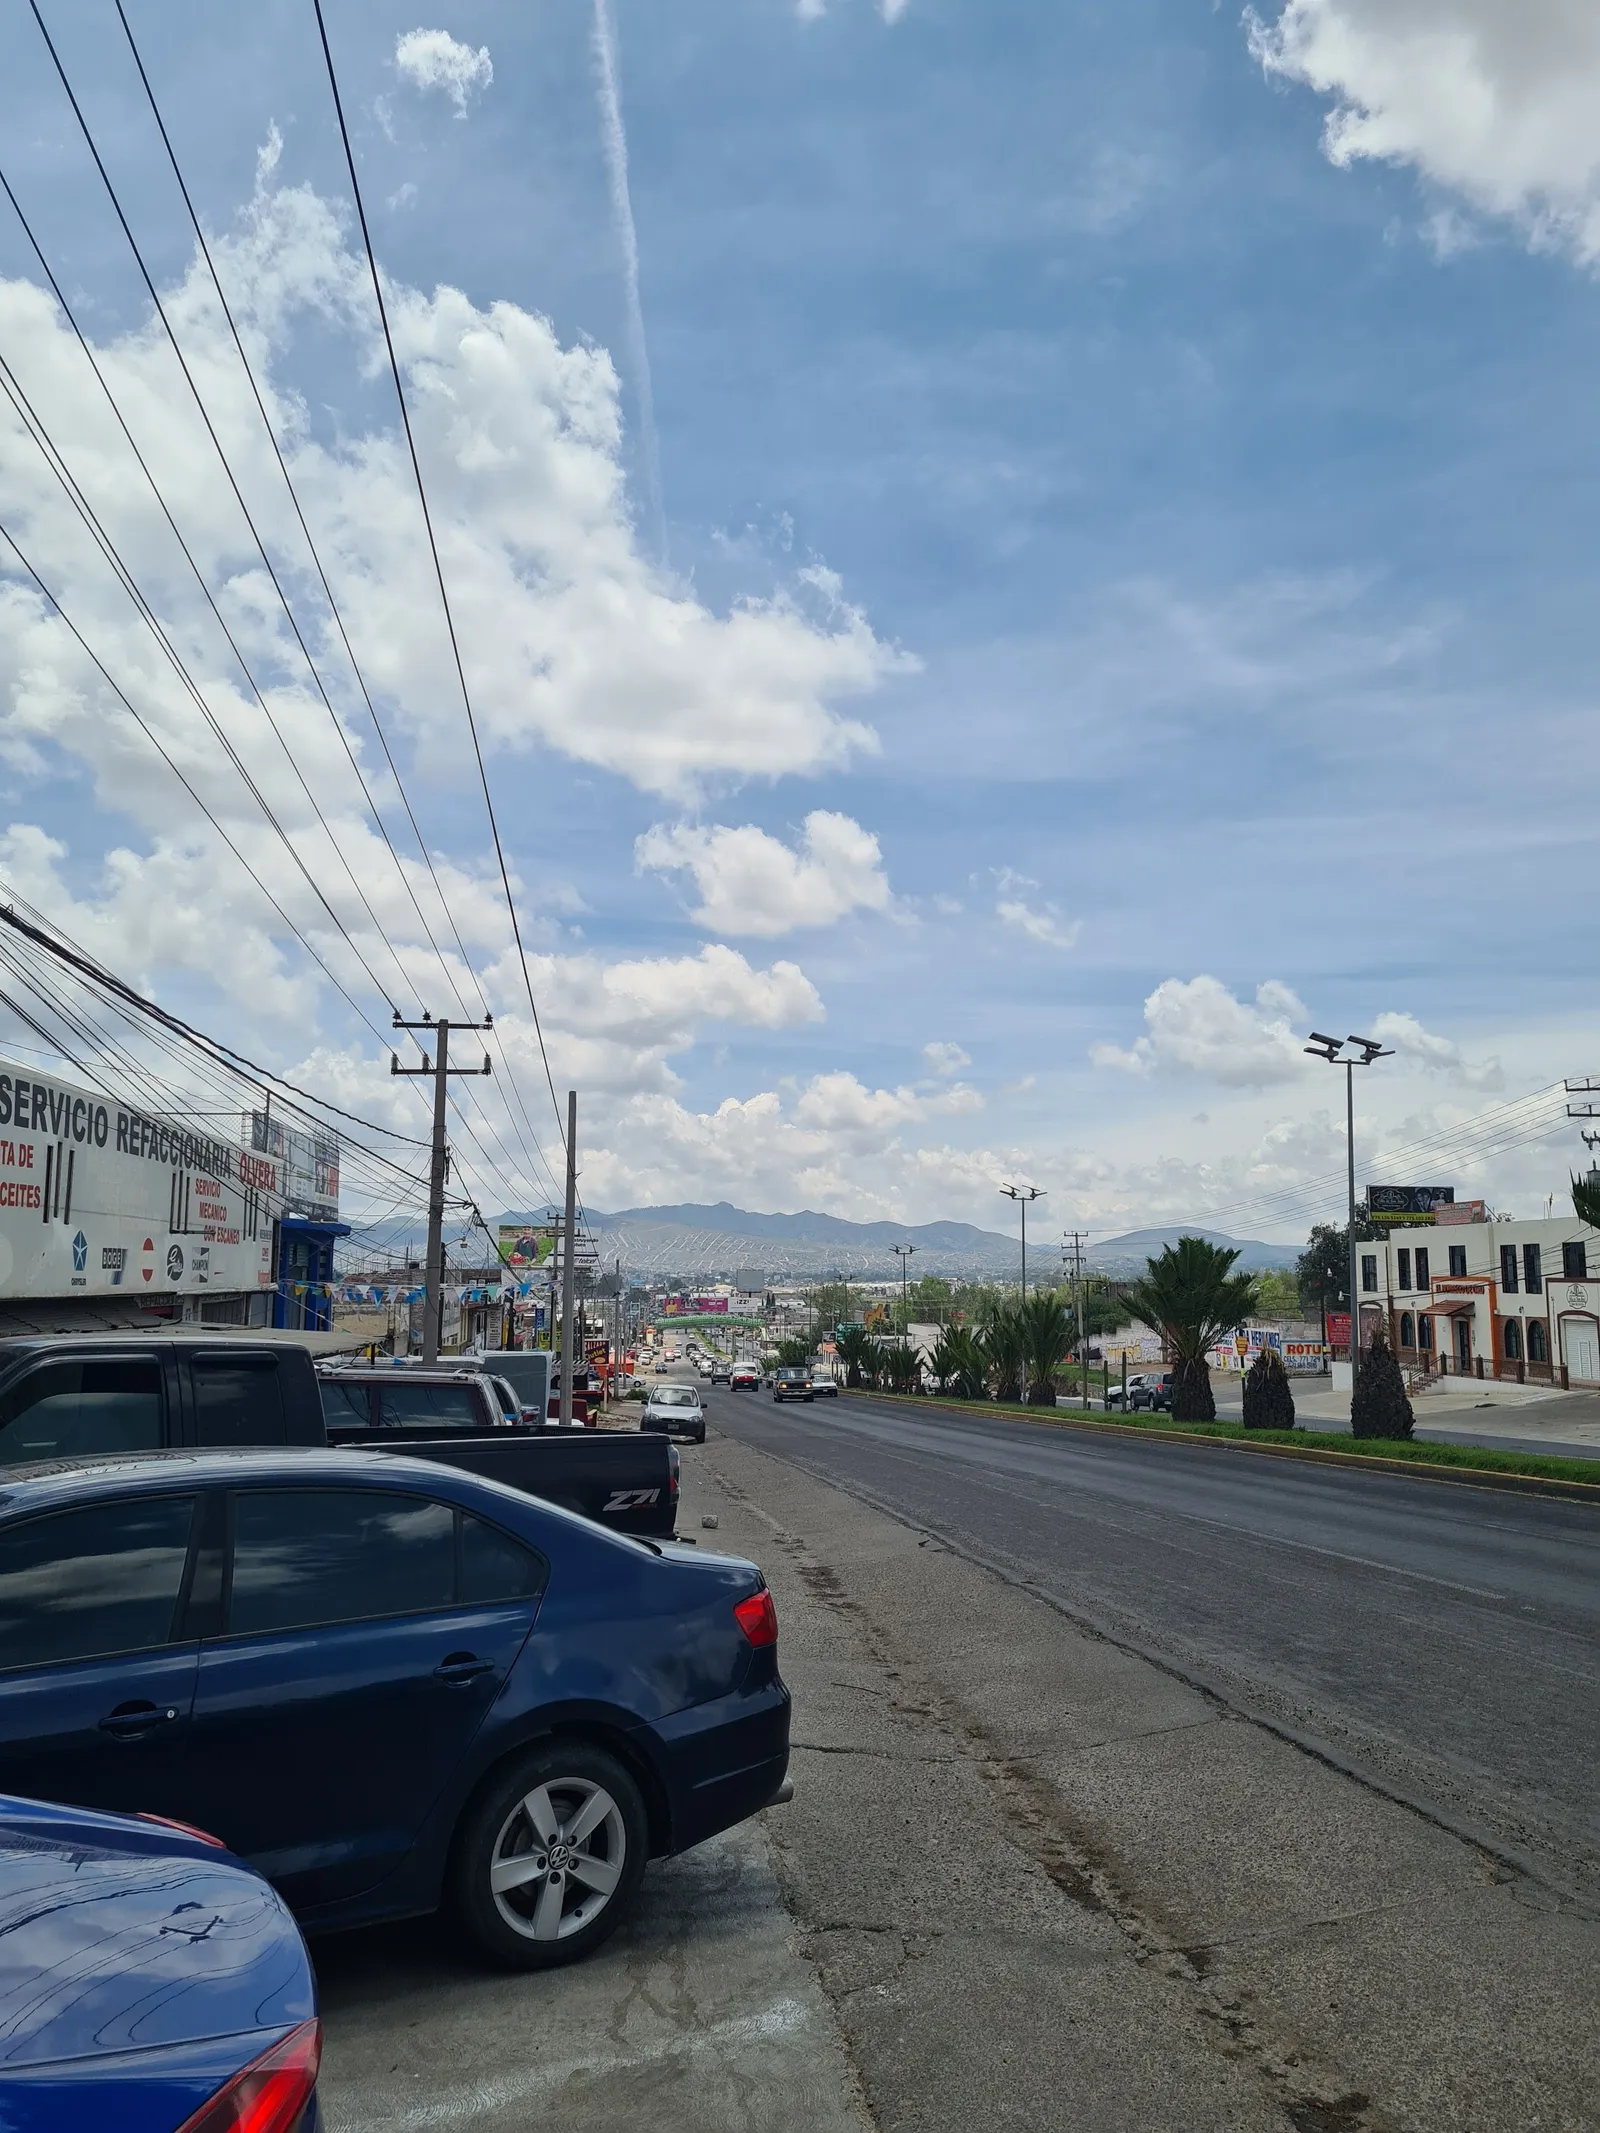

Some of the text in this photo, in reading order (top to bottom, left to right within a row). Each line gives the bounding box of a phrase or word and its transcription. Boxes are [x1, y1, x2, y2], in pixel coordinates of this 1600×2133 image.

[0, 1074, 108, 1148] SERVICIO
[116, 1111, 231, 1180] REFACCIONARIA
[18, 1143, 35, 1169] DE
[195, 1178, 221, 1198] SERVICIO
[199, 1201, 227, 1222] MECANICO
[217, 1226, 240, 1245] ESCANEO
[102, 1249, 121, 1269] BOGE
[602, 1488, 661, 1511] Z71
